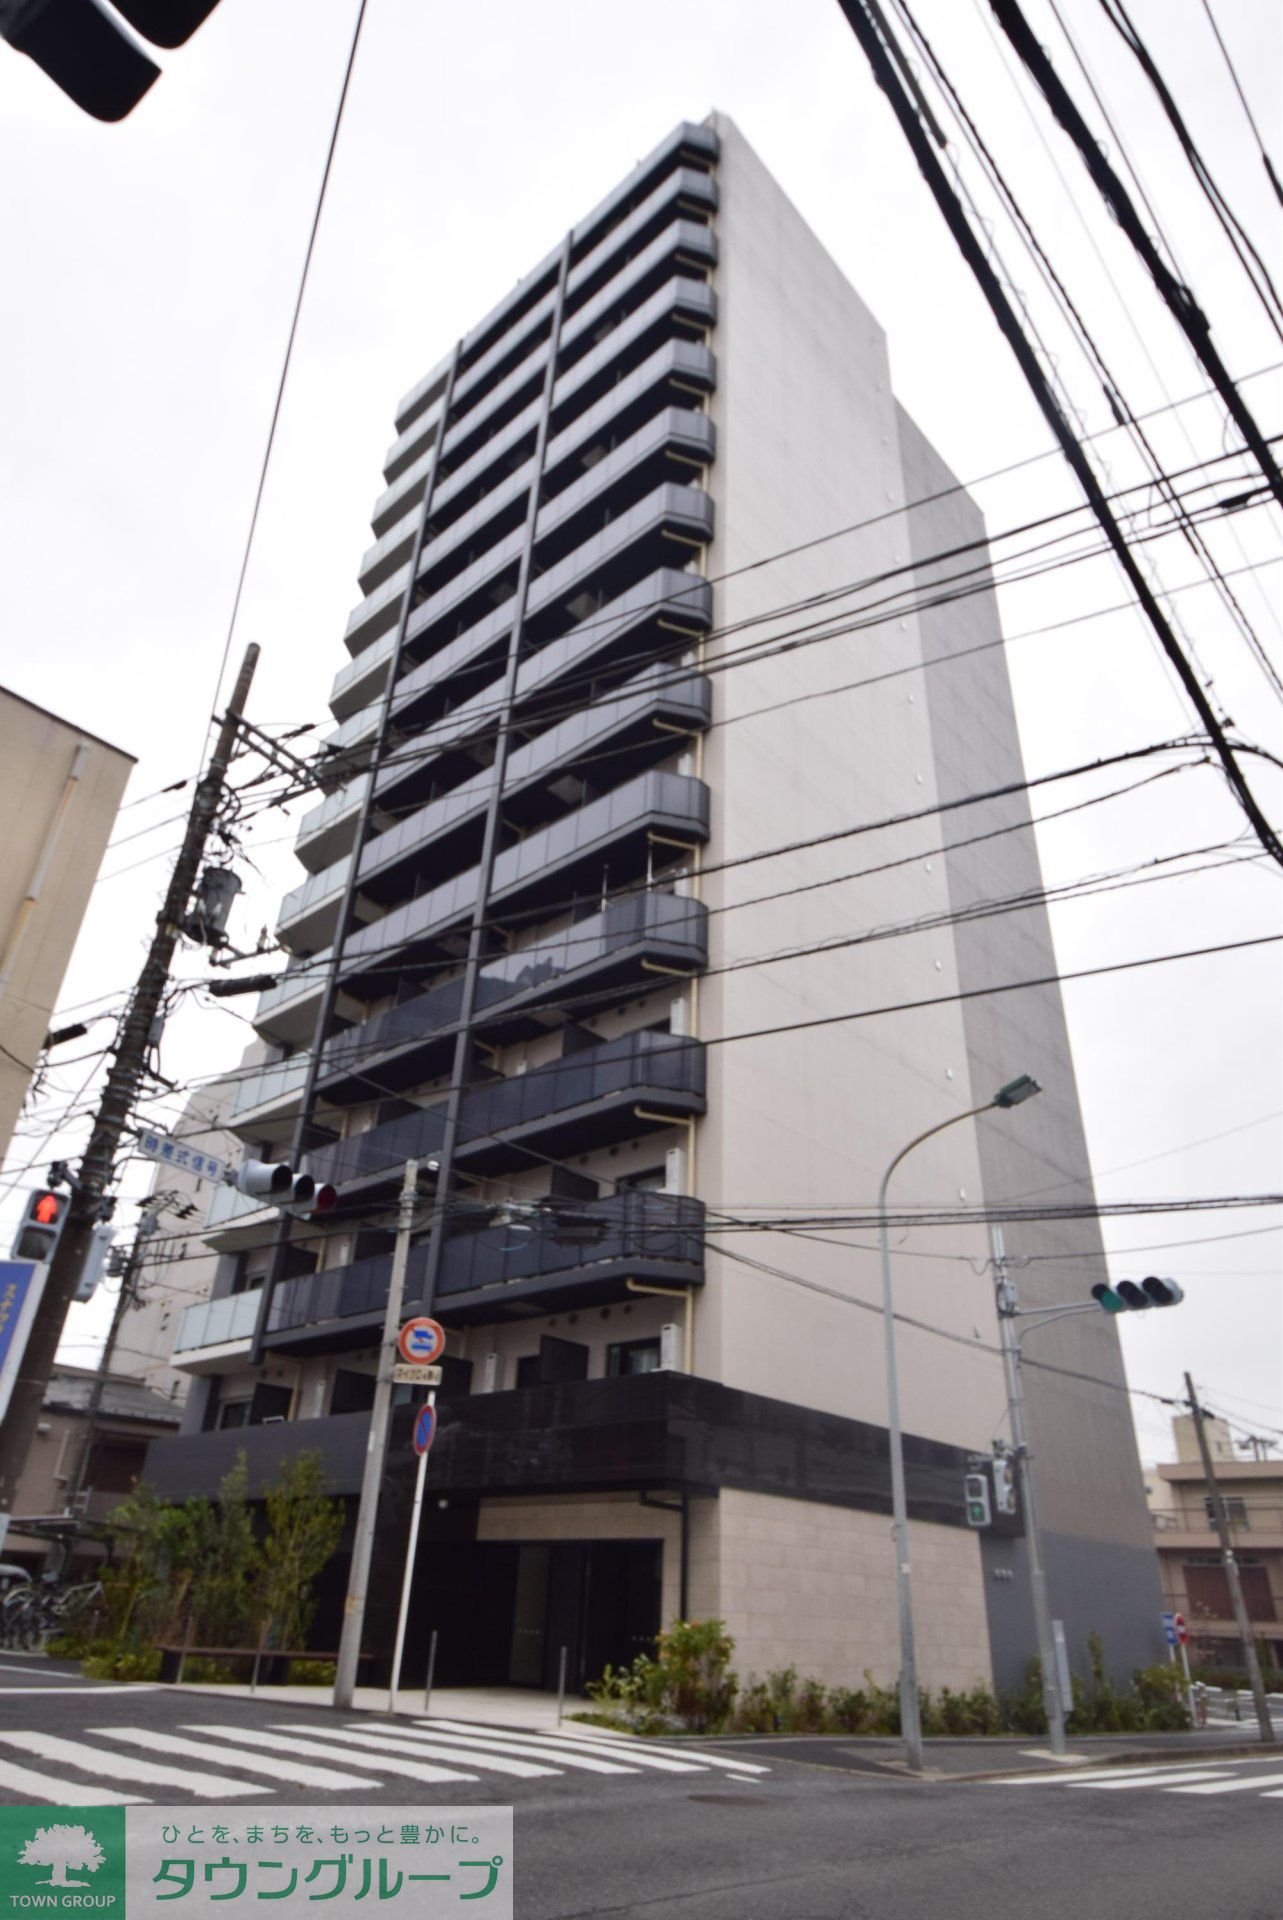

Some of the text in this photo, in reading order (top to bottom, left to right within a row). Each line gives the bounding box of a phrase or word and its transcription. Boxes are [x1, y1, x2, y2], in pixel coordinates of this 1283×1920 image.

[144, 1135, 218, 1177] 時差式信号
